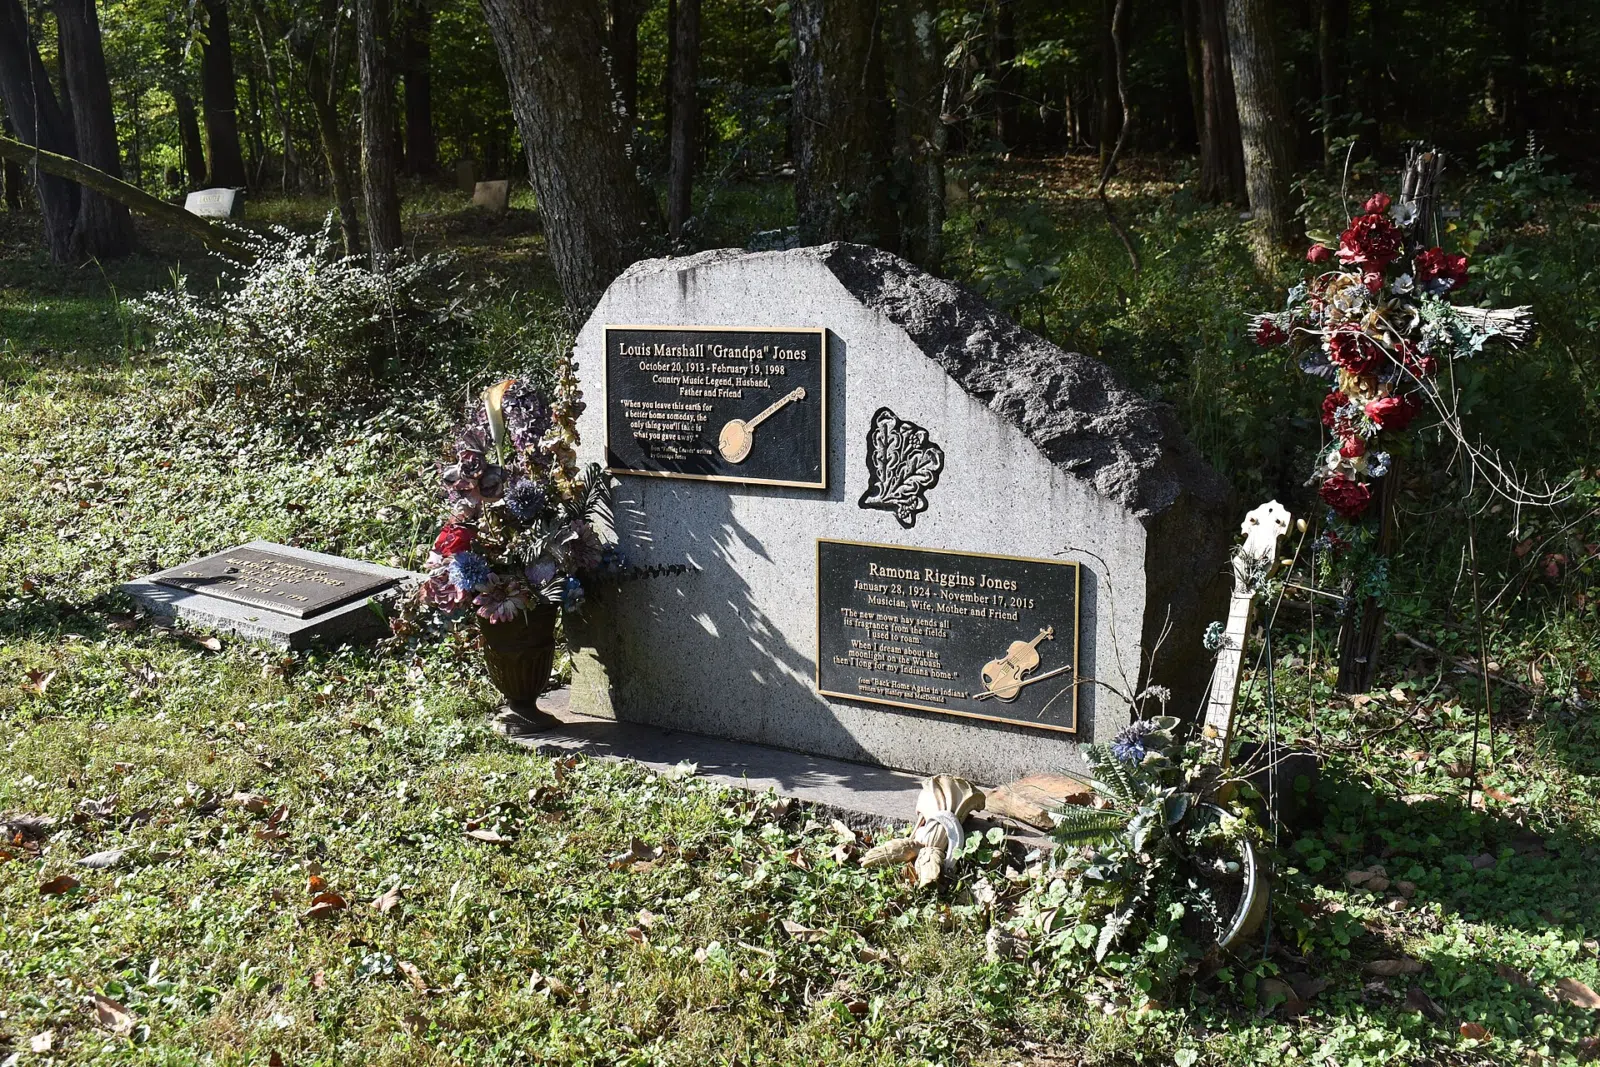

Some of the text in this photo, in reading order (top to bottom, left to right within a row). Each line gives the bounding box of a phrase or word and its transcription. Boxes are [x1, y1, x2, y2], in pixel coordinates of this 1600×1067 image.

[620, 343, 806, 361] Louis Marshall "Grandpa" Jones
[639, 362, 670, 371] October
[671, 363, 683, 373] 20,
[686, 363, 705, 372] 1913
[712, 364, 748, 375] February
[751, 365, 762, 375] 19,
[765, 365, 784, 375] 1998
[653, 375, 770, 388] Country Music Legend, Husband,
[680, 387, 742, 398] Father and Friend
[655, 401, 671, 409] leave
[649, 411, 665, 419] home
[667, 412, 695, 422] someday,
[630, 421, 643, 429] only
[645, 421, 661, 430] thing
[662, 422, 680, 431] you'll
[870, 563, 1017, 591] Ramona Riggins Jones
[854, 580, 888, 593] January
[891, 584, 904, 595] 28,
[908, 586, 930, 597] 1924
[941, 590, 989, 604] November
[992, 595, 1006, 607] 17,
[1011, 597, 1034, 608] 2015
[868, 595, 1018, 621] Musician, Wife, Mother and Friend
[841, 608, 858, 617] "The
[876, 613, 898, 622] mown
[901, 614, 914, 625] hay
[917, 617, 937, 627] sends
[940, 620, 949, 628] all
[844, 618, 946, 638] its fragrance from the fields
[872, 631, 889, 640] used
[851, 640, 872, 650] When
[880, 643, 902, 654] dream
[904, 646, 925, 656] about
[927, 648, 938, 658] the
[849, 650, 885, 662] moonlight
[899, 654, 910, 664] the
[912, 657, 941, 669] Wabash
[834, 656, 848, 665] then
[856, 658, 872, 669] long
[874, 660, 885, 669] for
[887, 663, 898, 672] my
[901, 664, 929, 676] Indiana
[931, 669, 958, 680] home."
[872, 678, 890, 687] "Back
[892, 681, 910, 690] Home
[912, 684, 930, 693] Again
[915, 693, 944, 703] MacDonald
